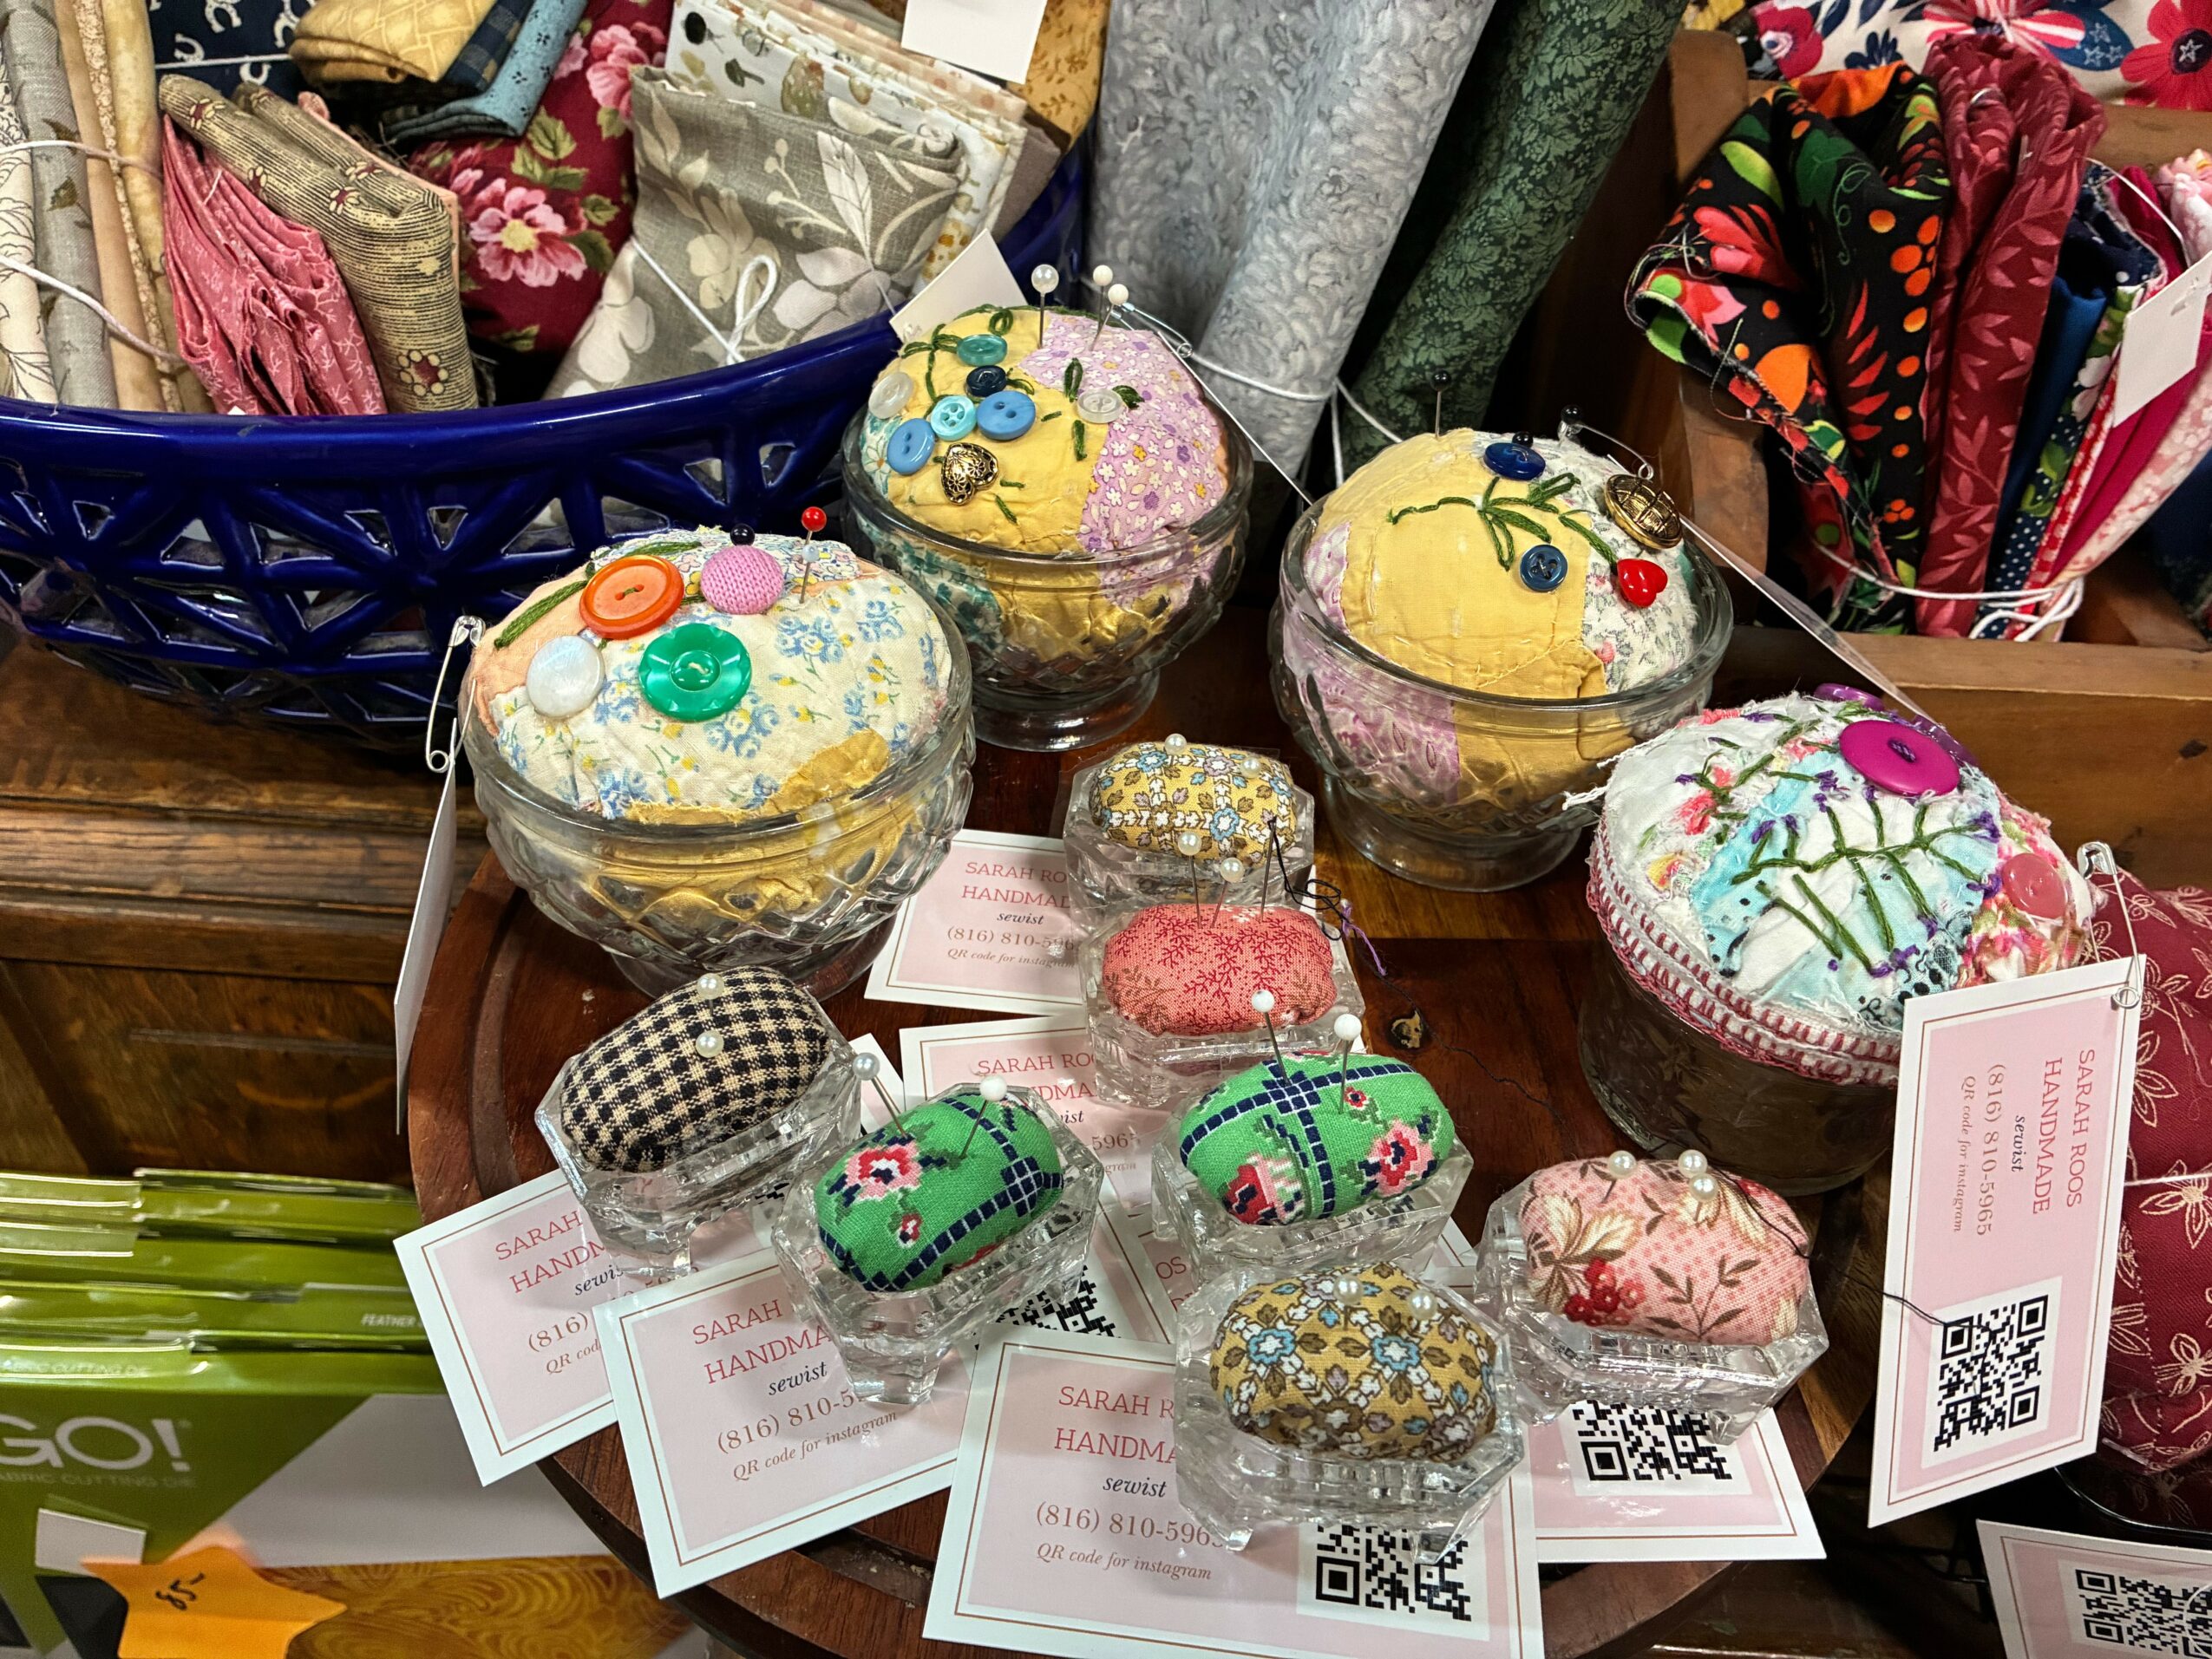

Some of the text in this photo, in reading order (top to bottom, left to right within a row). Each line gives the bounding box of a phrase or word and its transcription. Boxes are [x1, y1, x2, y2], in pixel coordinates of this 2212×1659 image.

[965, 861, 1068, 884] SARAH RO
[961, 885, 1071, 909] HANDMAD
[997, 912, 1044, 925] sewist
[947, 926, 1074, 951] (816) 810-596
[947, 948, 968, 959] QR
[972, 951, 997, 961] code
[998, 954, 1016, 964] for
[978, 1052, 1095, 1074] SARAH RO
[2011, 1114, 2027, 1172] sewist
[2032, 1056, 2064, 1215] HANDMADE
[2066, 1048, 2095, 1208] SARAH ROOS
[1952, 1075, 1976, 1233] QR code for instagram
[1976, 1064, 2006, 1236] (816) 810-5965
[494, 1210, 583, 1261] SARAH
[574, 1264, 624, 1297] sewi
[1155, 1256, 1187, 1279] OS
[528, 1311, 589, 1353] (816)
[691, 1299, 783, 1345] SARAH
[546, 1338, 602, 1375] QR cod
[704, 1324, 832, 1385] HANDMA
[768, 1361, 828, 1396] sewist
[1058, 1386, 1151, 1416] SARAH
[717, 1388, 865, 1454] (816) 810-5
[733, 1411, 898, 1482] QR code for instagram
[1103, 1476, 1168, 1498] sewist
[1037, 1501, 1100, 1533] (816)
[1037, 1543, 1212, 1581] QR code for instagram
